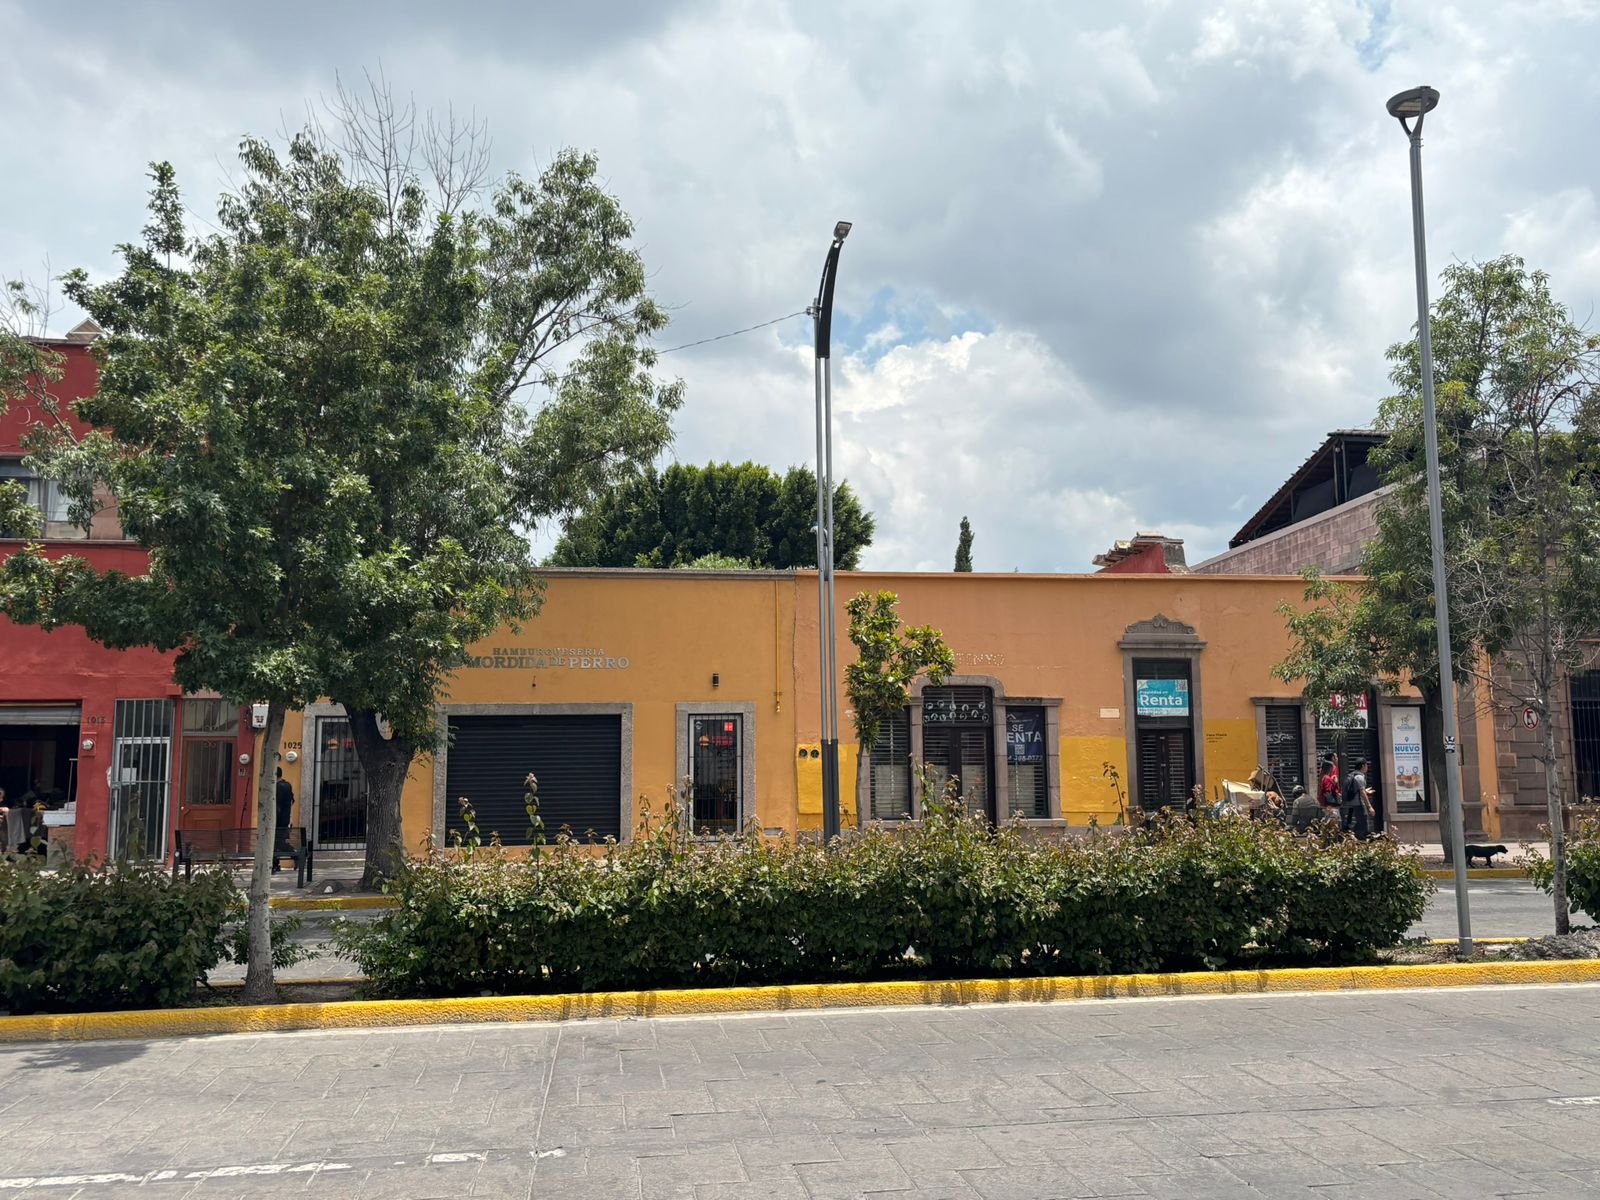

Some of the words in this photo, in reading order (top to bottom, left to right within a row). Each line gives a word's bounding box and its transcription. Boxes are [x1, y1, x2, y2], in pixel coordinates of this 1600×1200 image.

[551, 657, 566, 666] DE
[569, 657, 630, 669] PERRO
[1140, 695, 1183, 706] Renta
[1012, 724, 1024, 732] SE
[1007, 732, 1042, 743] ENTA
[1394, 745, 1420, 753] NUEVO
